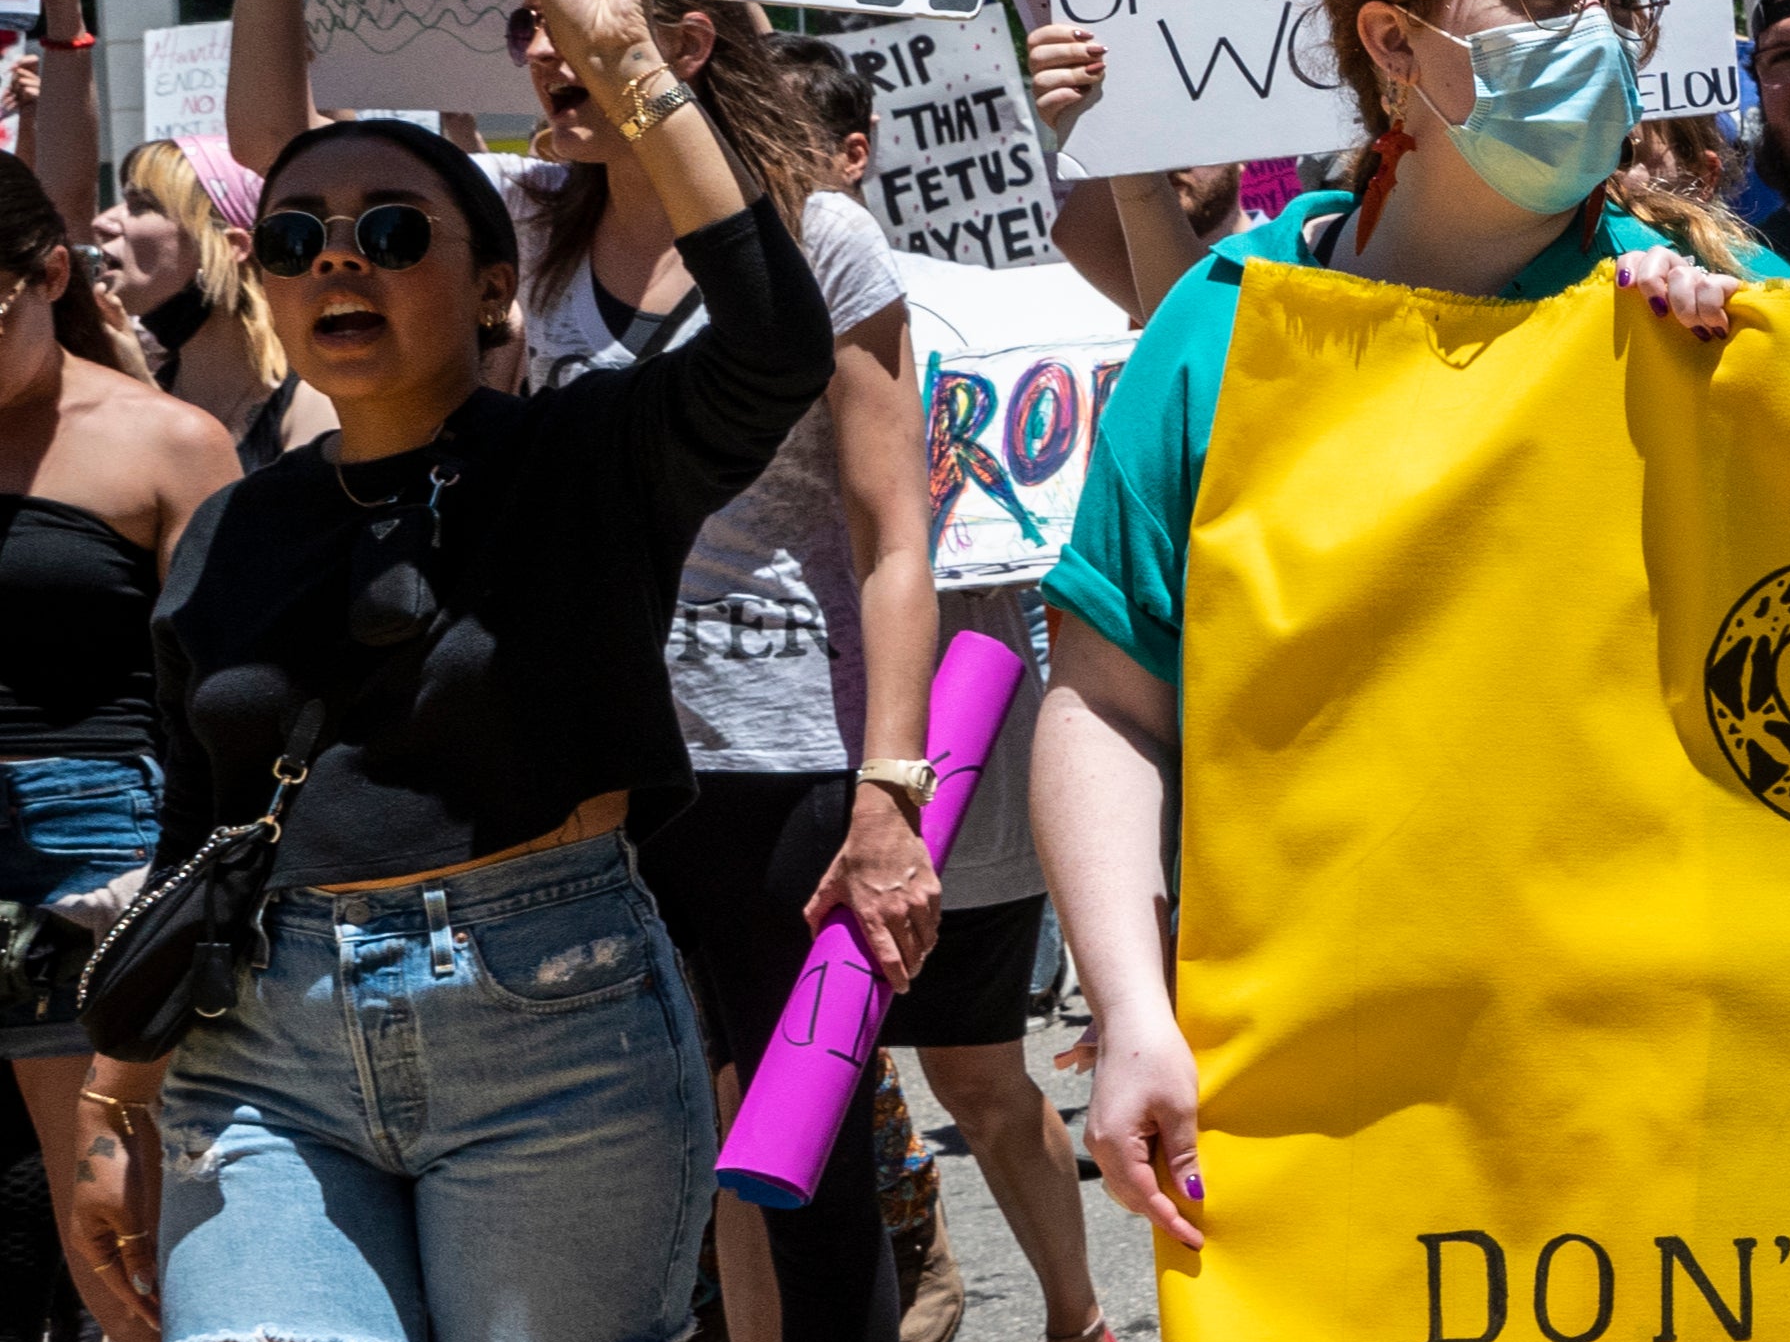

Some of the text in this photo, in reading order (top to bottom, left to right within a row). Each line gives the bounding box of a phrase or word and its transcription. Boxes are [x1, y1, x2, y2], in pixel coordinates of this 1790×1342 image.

[850, 35, 936, 92] RIP
[892, 86, 1006, 151] THAT
[879, 143, 1035, 227] FETUS
